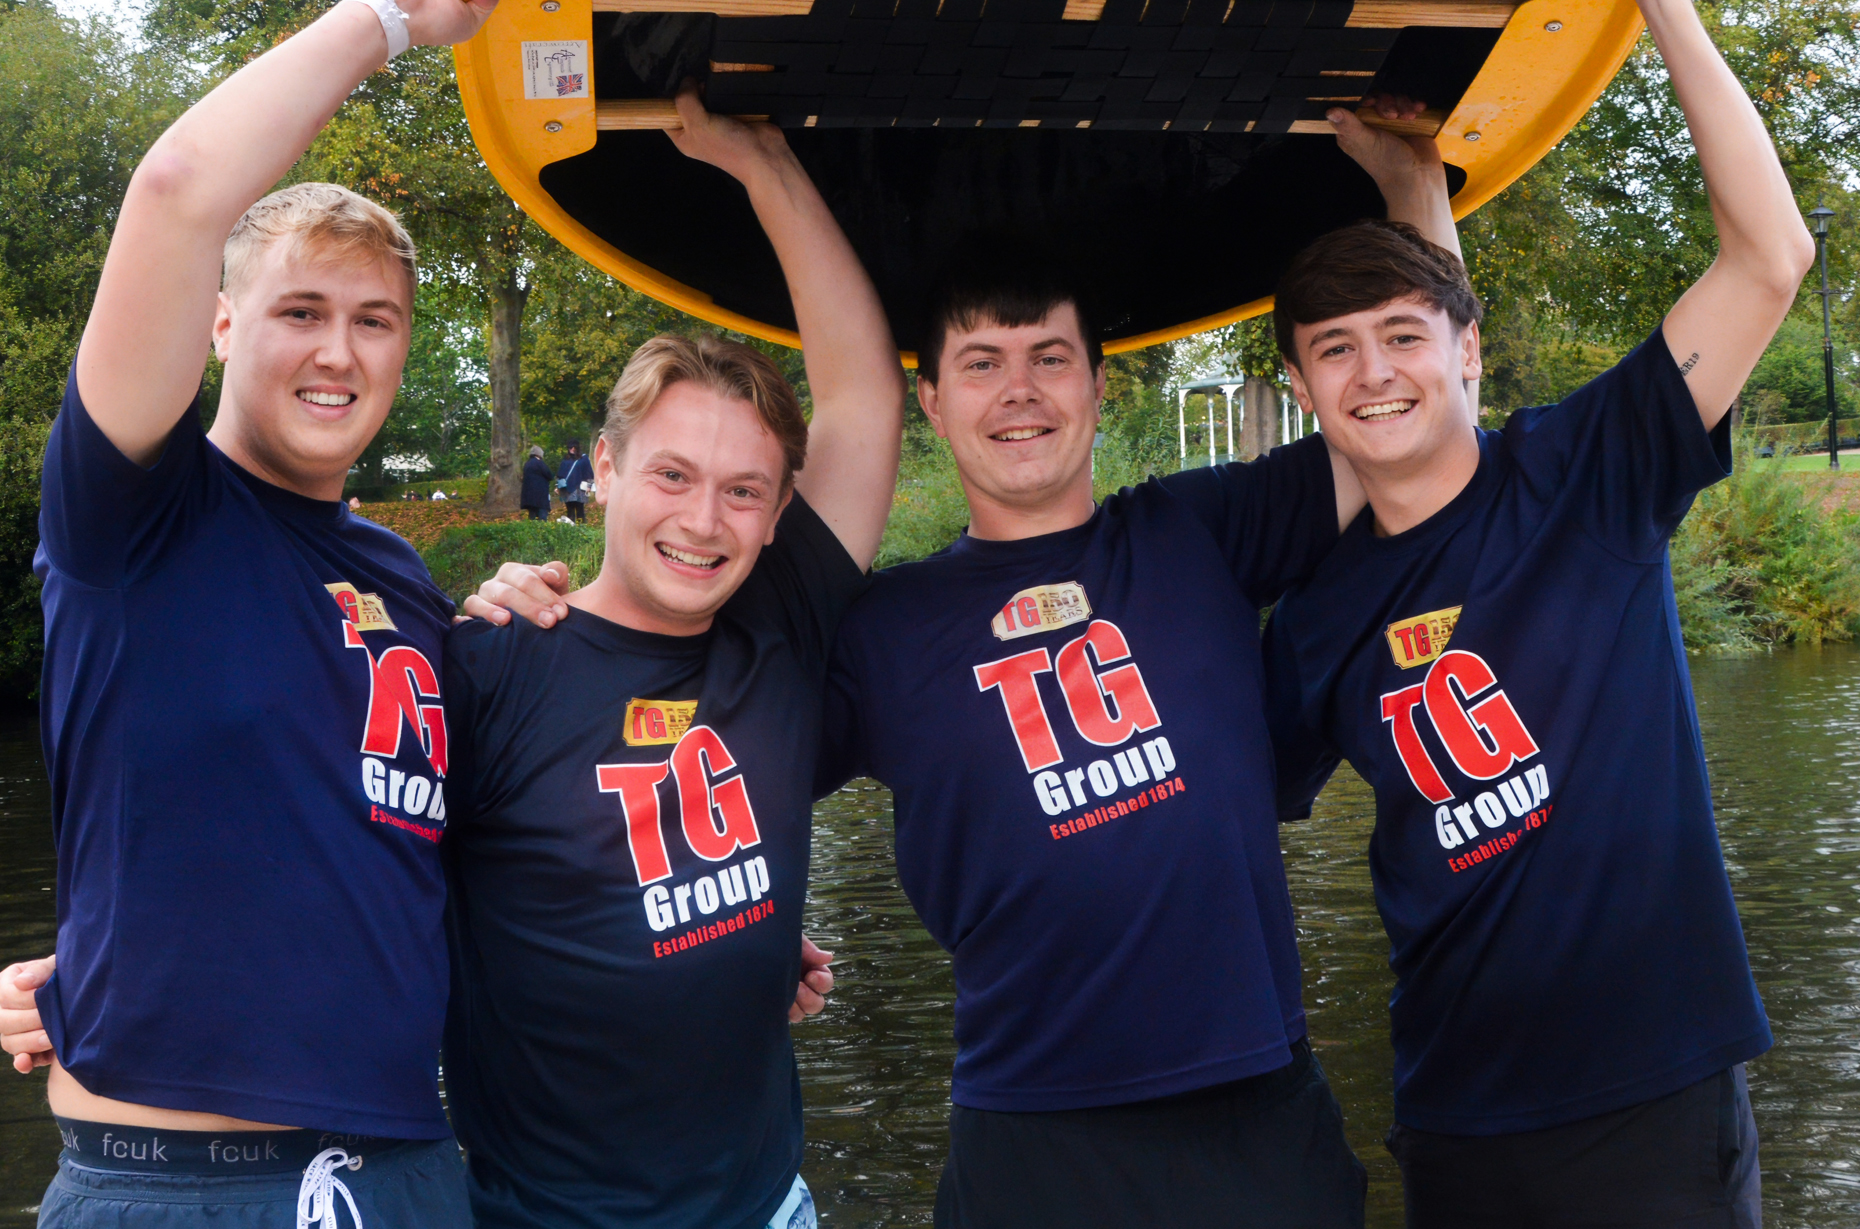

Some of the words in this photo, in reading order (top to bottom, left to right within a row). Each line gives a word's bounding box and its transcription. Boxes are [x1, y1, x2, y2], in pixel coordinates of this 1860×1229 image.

[1002, 596, 1041, 633] TG
[1037, 589, 1080, 616] 150
[1044, 606, 1084, 624] YEARS
[1394, 623, 1432, 661] TG
[633, 706, 667, 739] TG
[973, 618, 1163, 774] TG
[1379, 649, 1541, 805] TG
[1033, 736, 1176, 816] Group
[596, 724, 762, 888] TG
[1049, 791, 1149, 841] Established
[1148, 776, 1186, 803] 1874
[1434, 763, 1550, 850] Group
[643, 855, 770, 932] Group
[653, 913, 746, 958] Established
[745, 899, 775, 925] 1874
[61, 1127, 80, 1152] cuk
[102, 1132, 168, 1162] fcuk
[208, 1139, 280, 1163] fcuk
